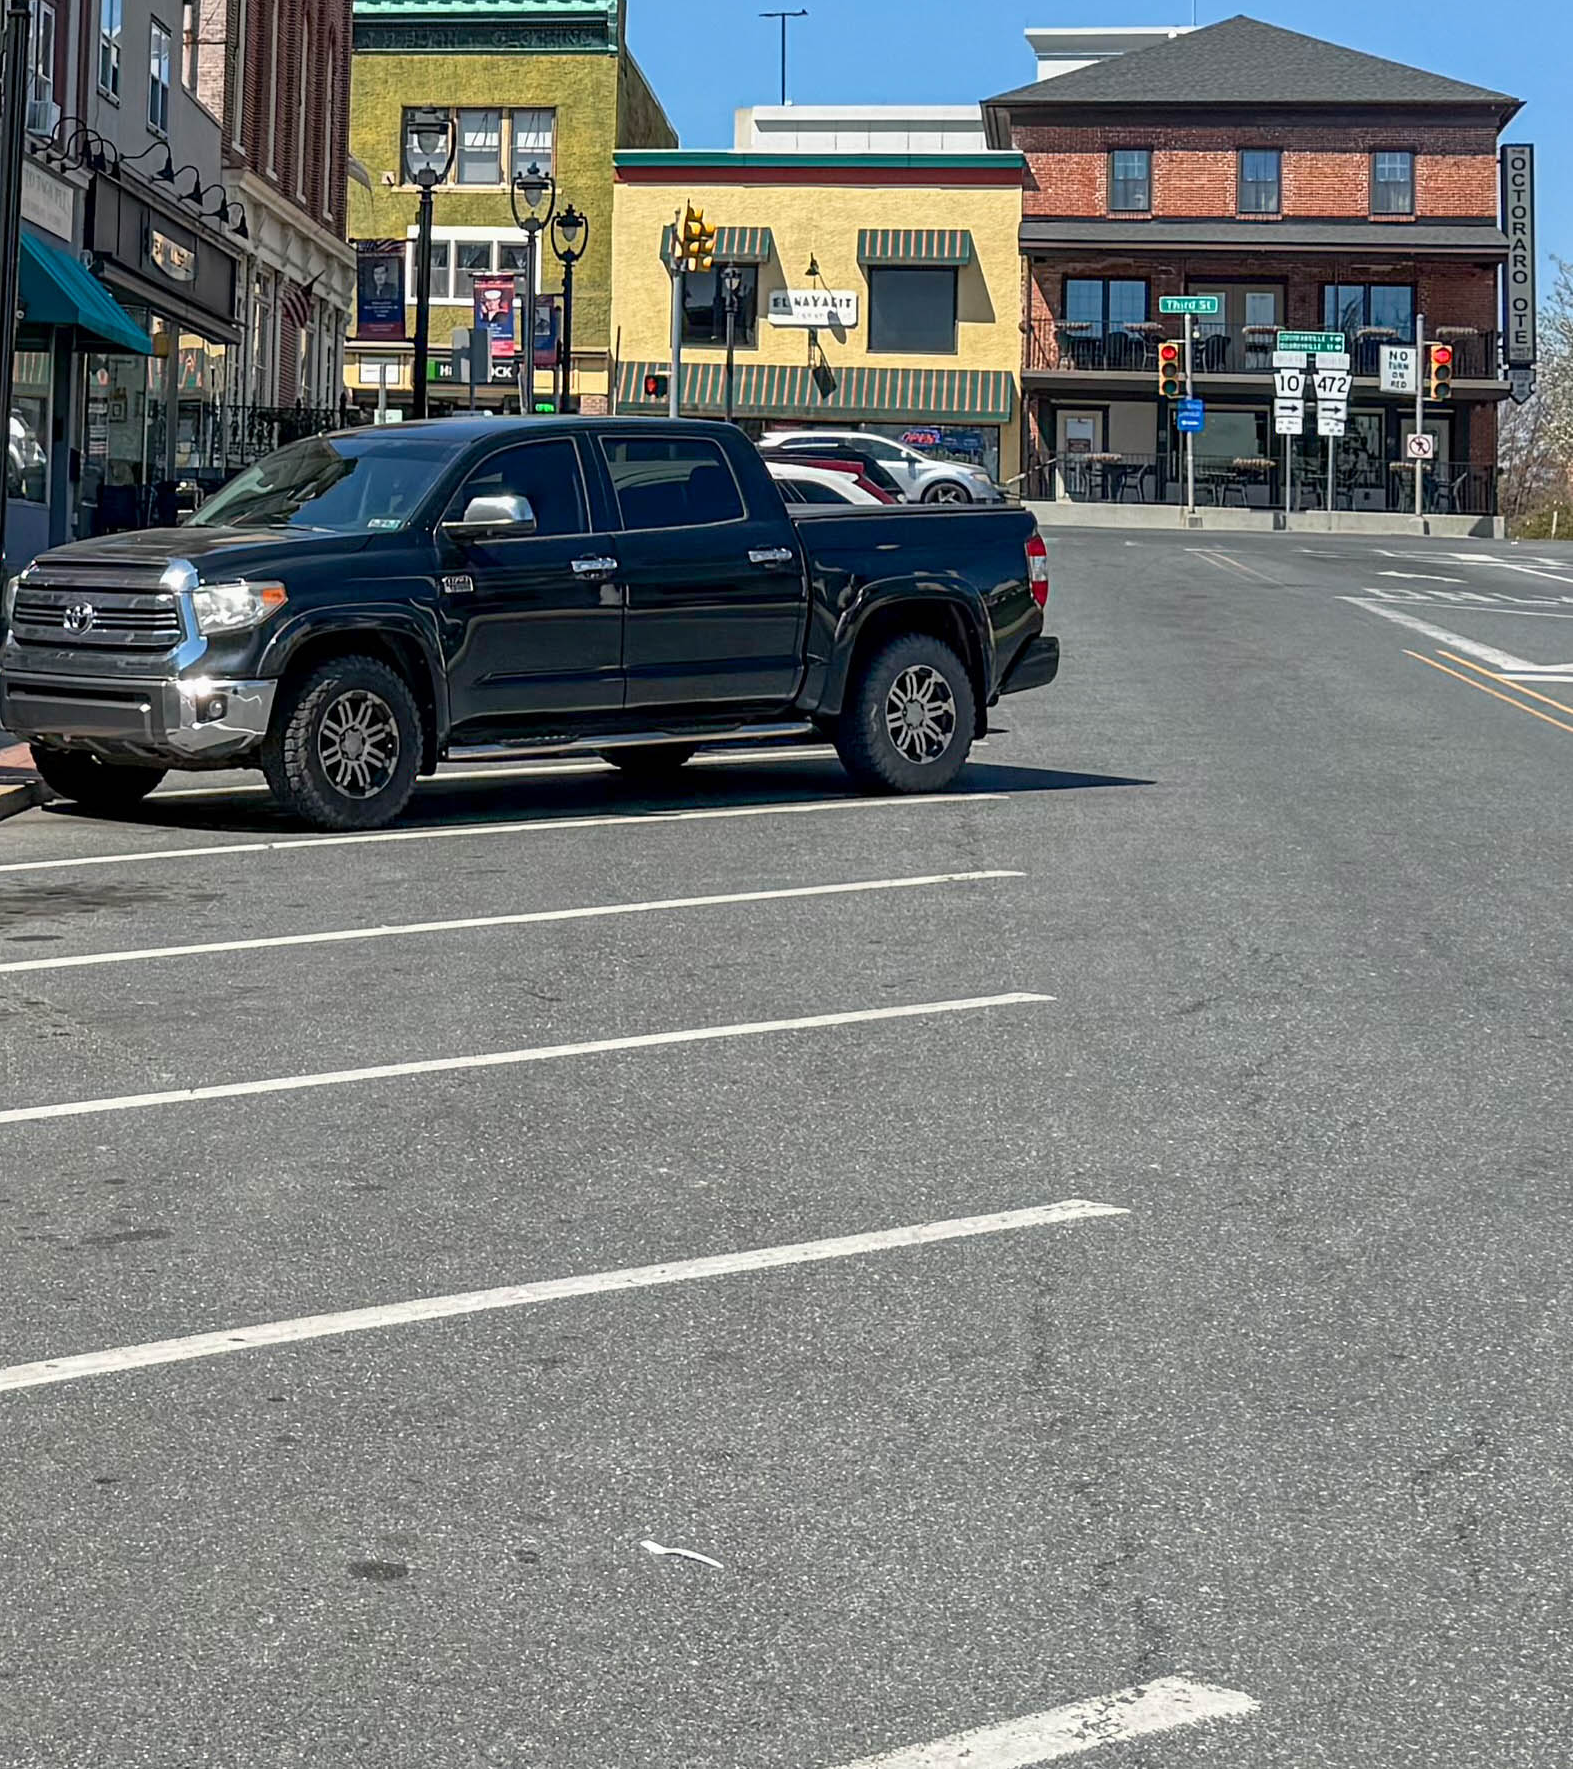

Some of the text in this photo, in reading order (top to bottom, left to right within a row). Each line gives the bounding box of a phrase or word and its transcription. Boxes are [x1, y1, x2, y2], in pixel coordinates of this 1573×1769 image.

[1510, 157, 1528, 284] OCTORARO
[773, 296, 790, 308] EL
[1166, 300, 1211, 310] Third St
[1389, 350, 1408, 361] NO
[1392, 371, 1404, 379] ON
[1280, 375, 1300, 392] 10
[1317, 376, 1347, 393] 472
